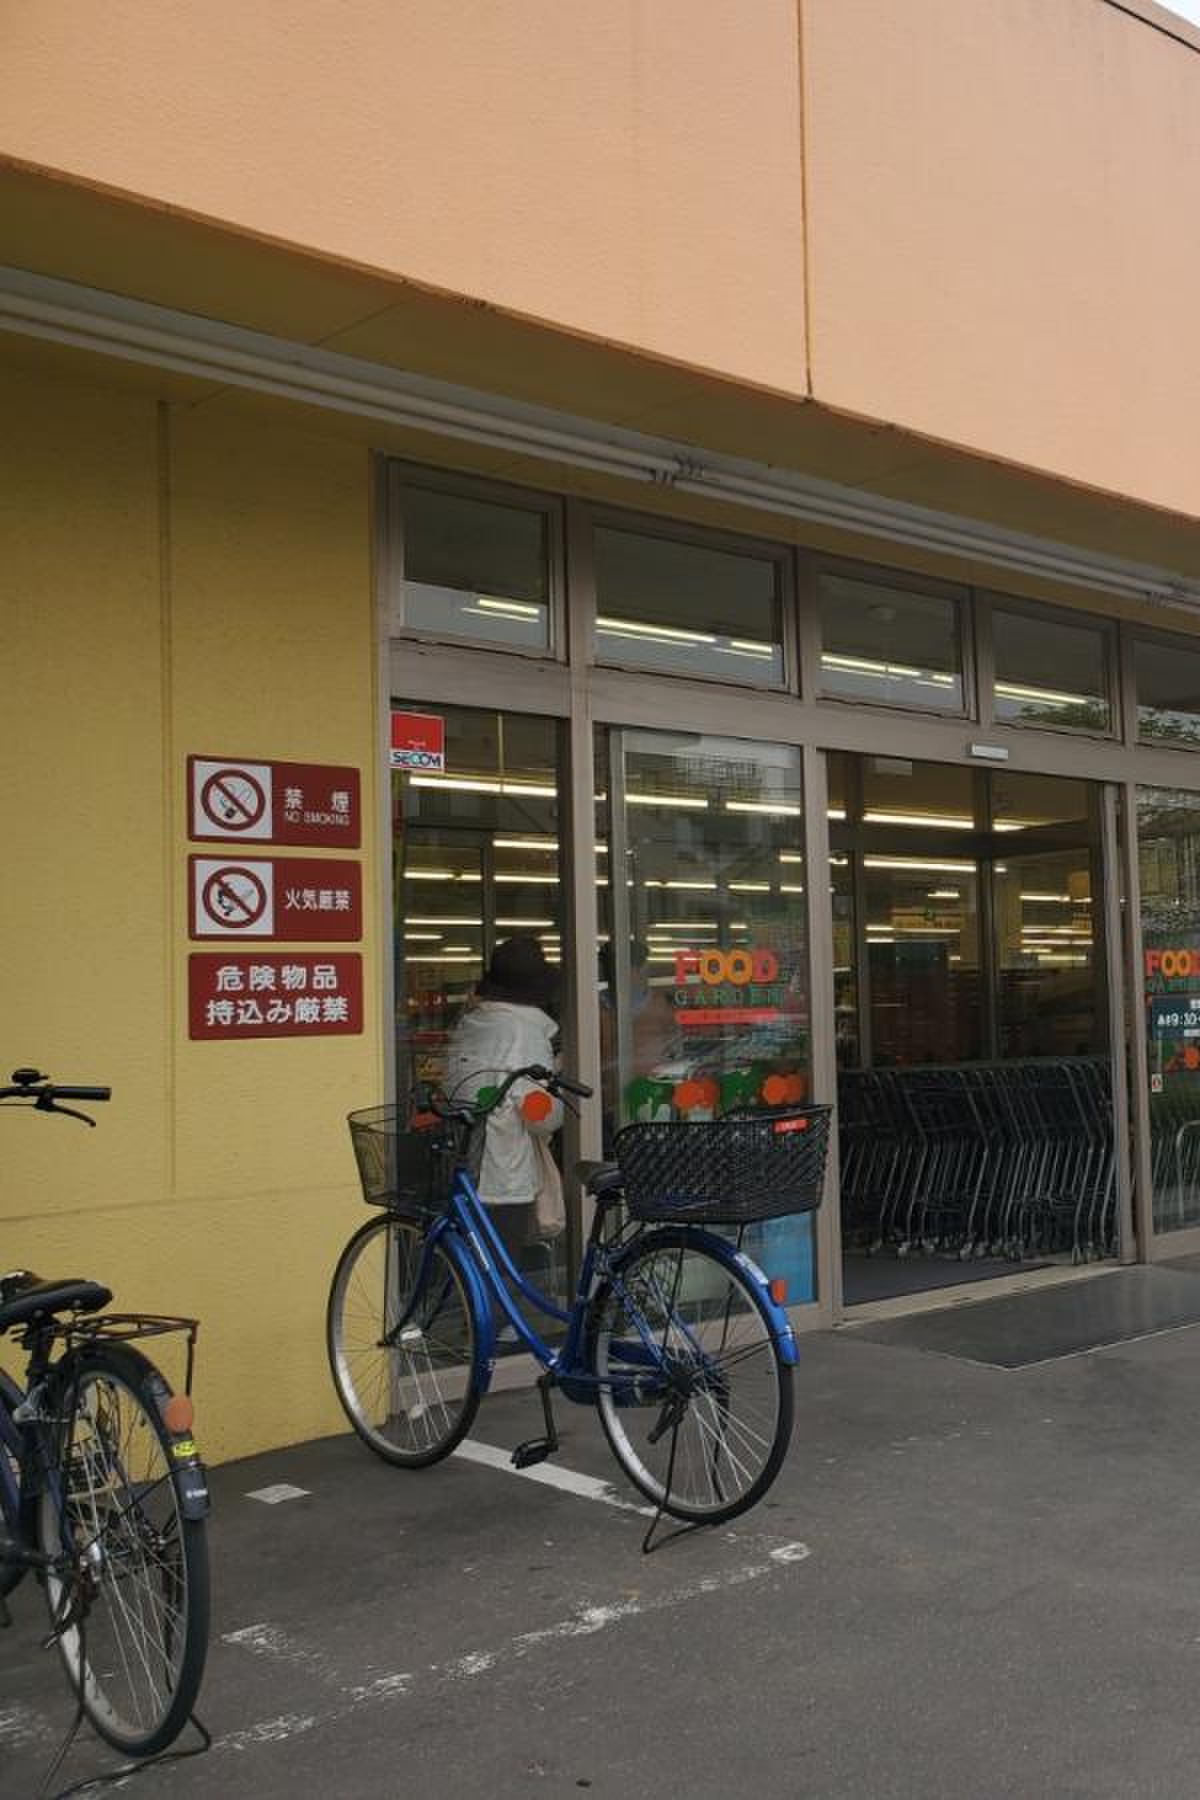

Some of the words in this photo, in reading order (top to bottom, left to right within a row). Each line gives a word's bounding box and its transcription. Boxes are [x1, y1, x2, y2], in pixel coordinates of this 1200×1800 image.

[392, 751, 442, 767] SECOM
[284, 810, 301, 823] NO
[303, 811, 350, 827] SMOKING
[285, 888, 351, 913] 火気厳禁
[215, 964, 338, 992] 危険物品
[672, 949, 778, 986] FOOD
[206, 996, 349, 1026] 持込み厳禁
